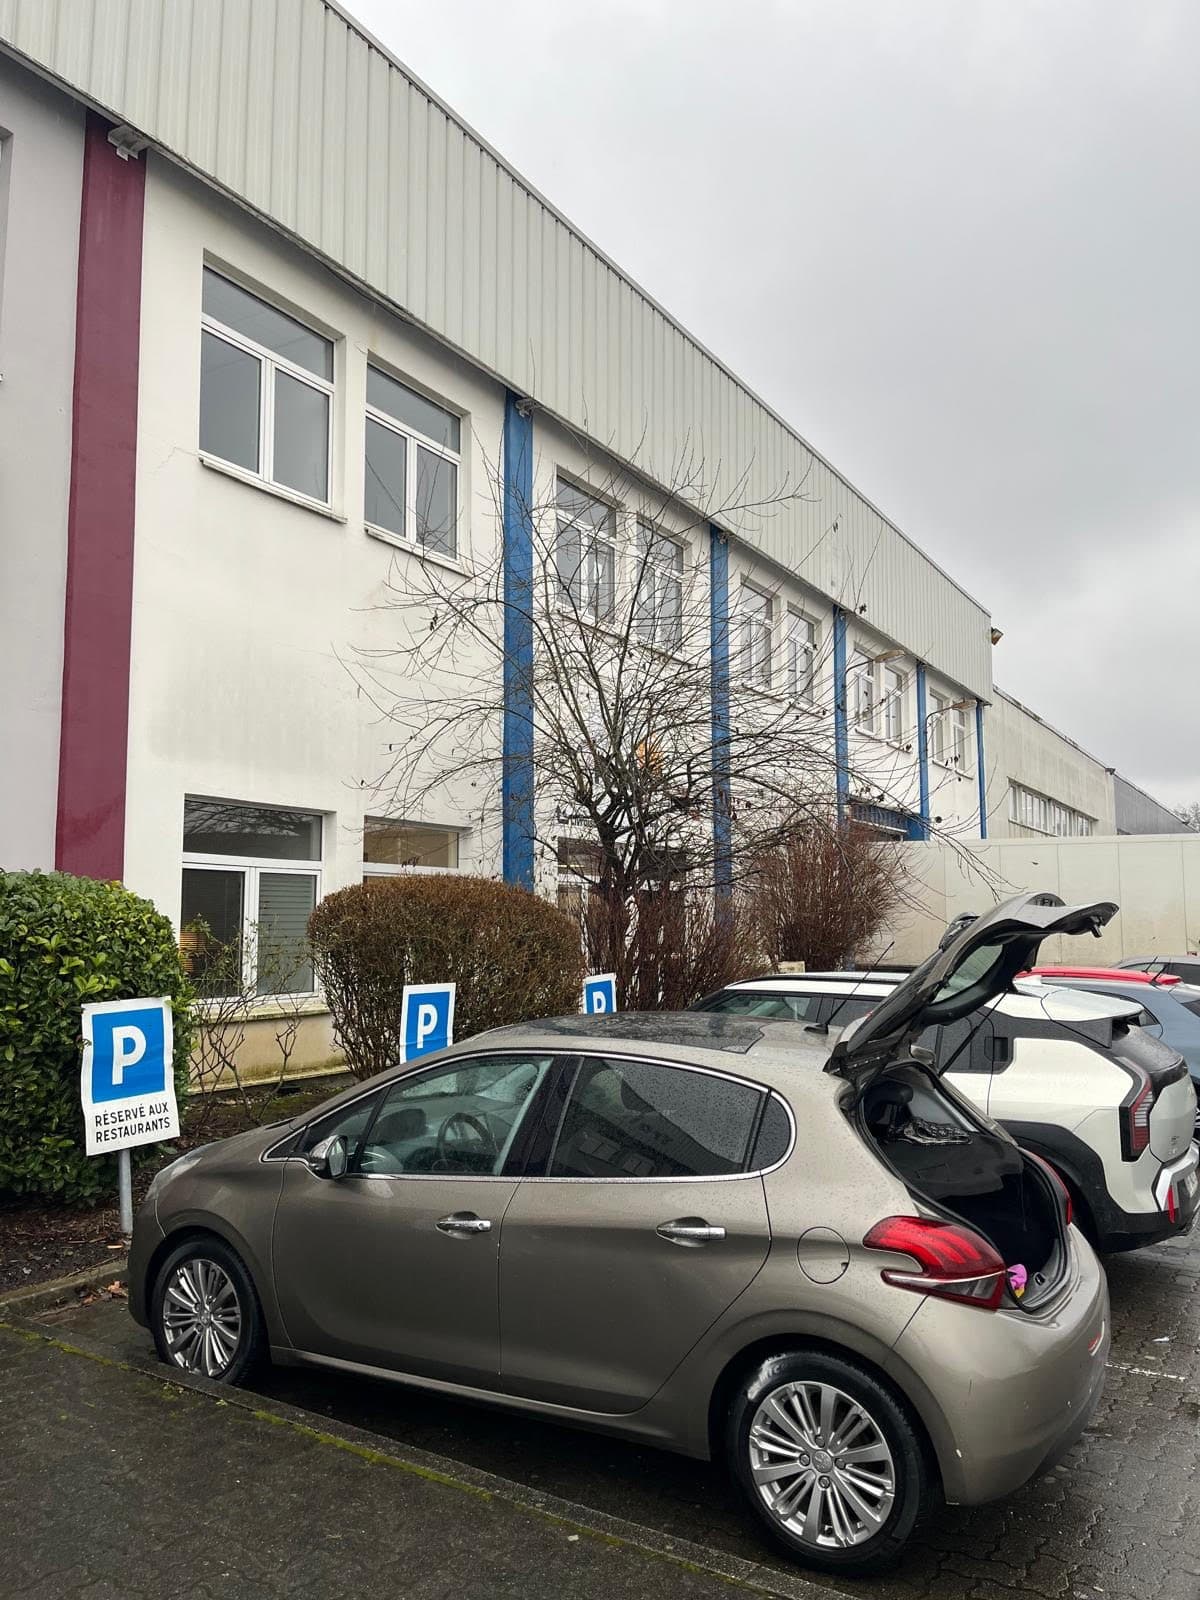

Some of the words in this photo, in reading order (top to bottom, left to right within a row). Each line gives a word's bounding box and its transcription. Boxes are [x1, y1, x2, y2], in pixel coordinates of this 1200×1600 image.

[417, 1004, 438, 1049] P
[112, 1025, 147, 1085] P
[95, 1105, 146, 1127] RÉSERVÉ
[149, 1102, 169, 1115] AUX
[96, 1117, 170, 1143] RESTAURANTS
